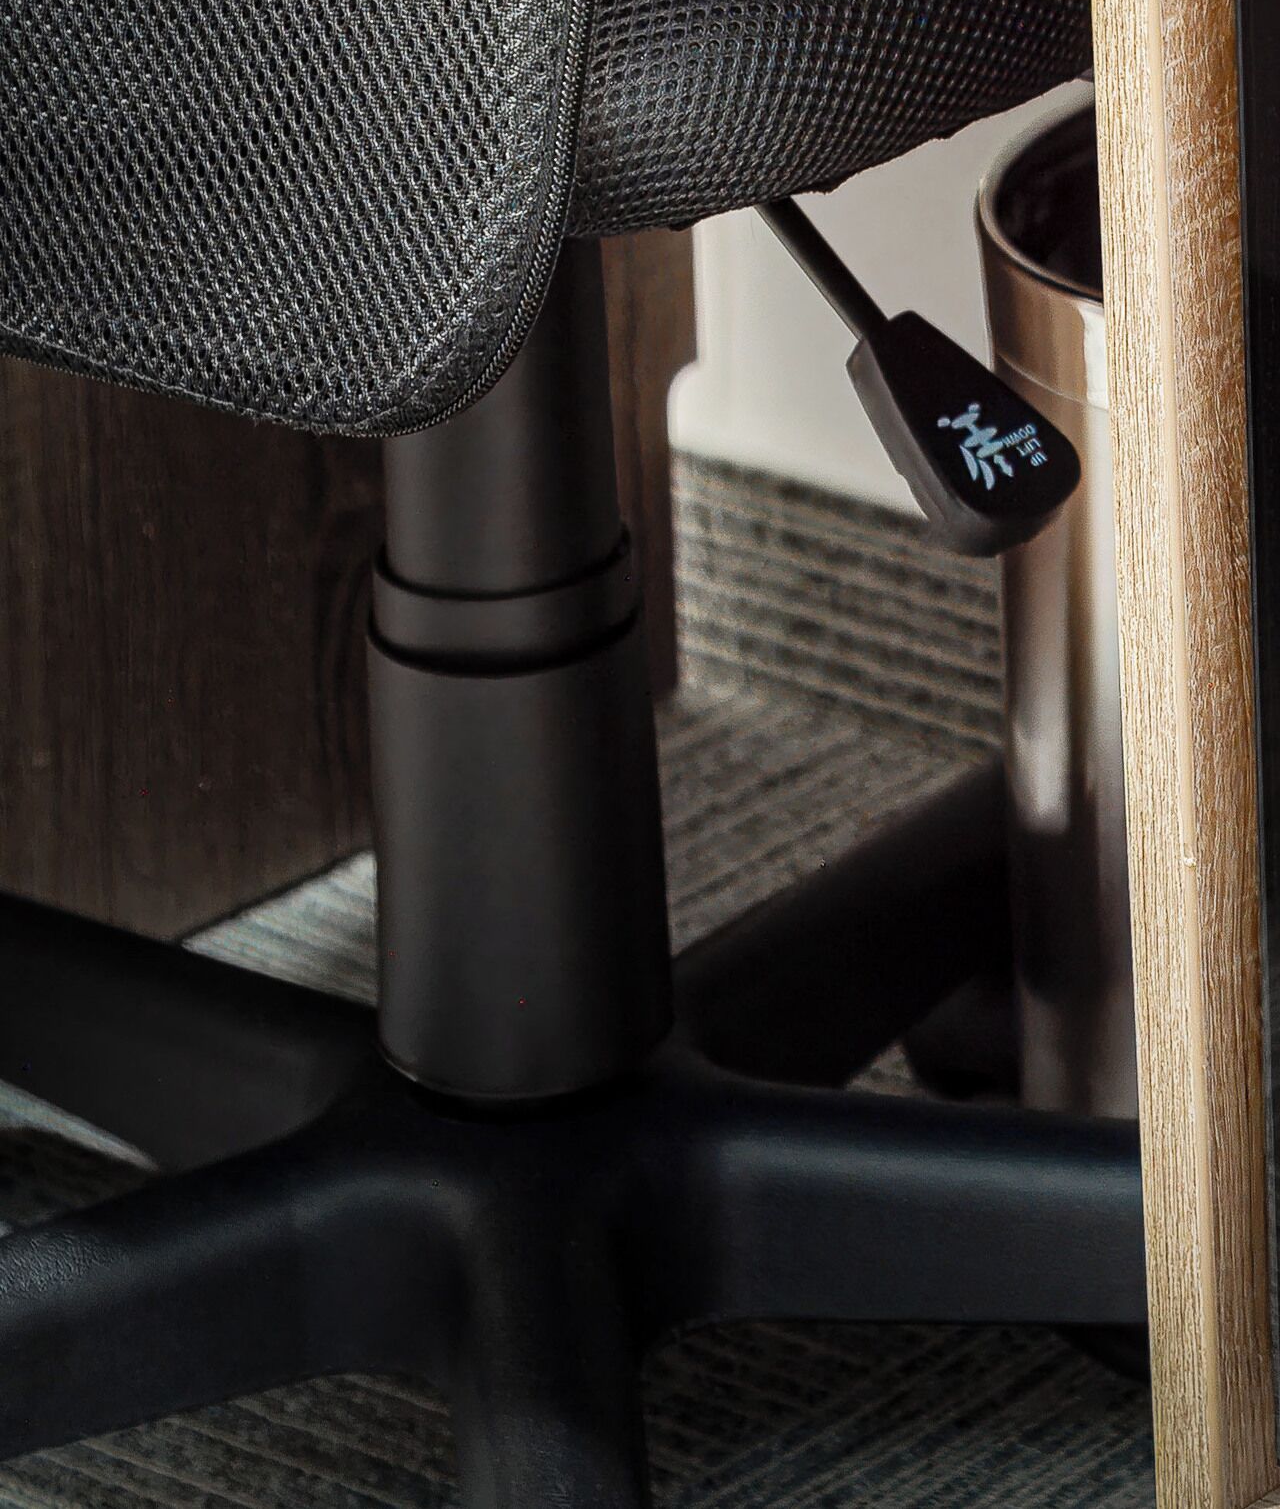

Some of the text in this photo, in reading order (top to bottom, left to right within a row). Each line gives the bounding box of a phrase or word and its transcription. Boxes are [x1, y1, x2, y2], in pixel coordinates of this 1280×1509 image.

[1002, 423, 1037, 448] DOWN
[1016, 438, 1041, 457] LIFT
[1030, 453, 1048, 467] UP
